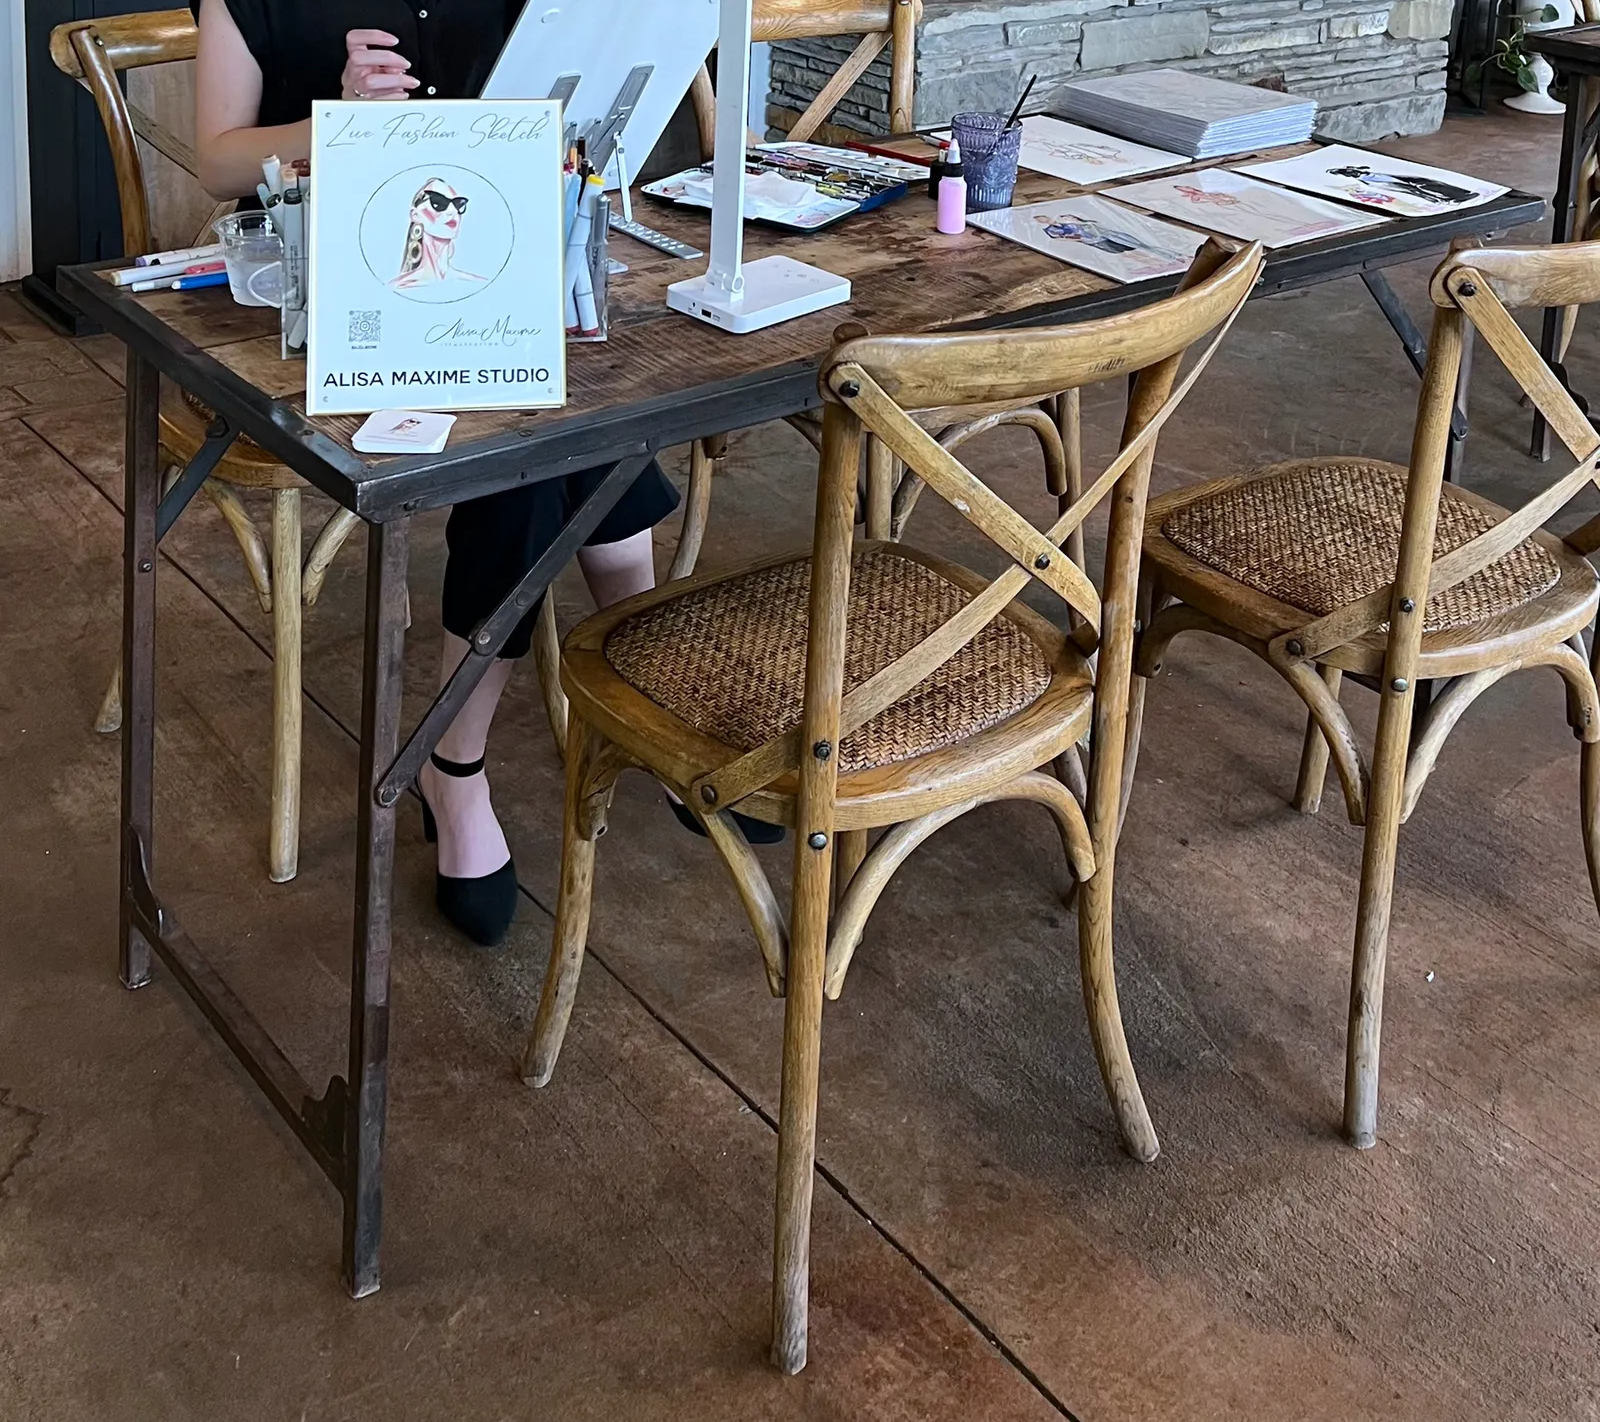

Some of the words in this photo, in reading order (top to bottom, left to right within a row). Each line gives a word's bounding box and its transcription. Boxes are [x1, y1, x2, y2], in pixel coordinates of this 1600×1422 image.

[383, 112, 456, 148] Fashion
[468, 113, 549, 148] Sketch
[323, 372, 384, 387] ALISA
[392, 370, 471, 386] MAXIME
[477, 368, 549, 384] STUDIO
